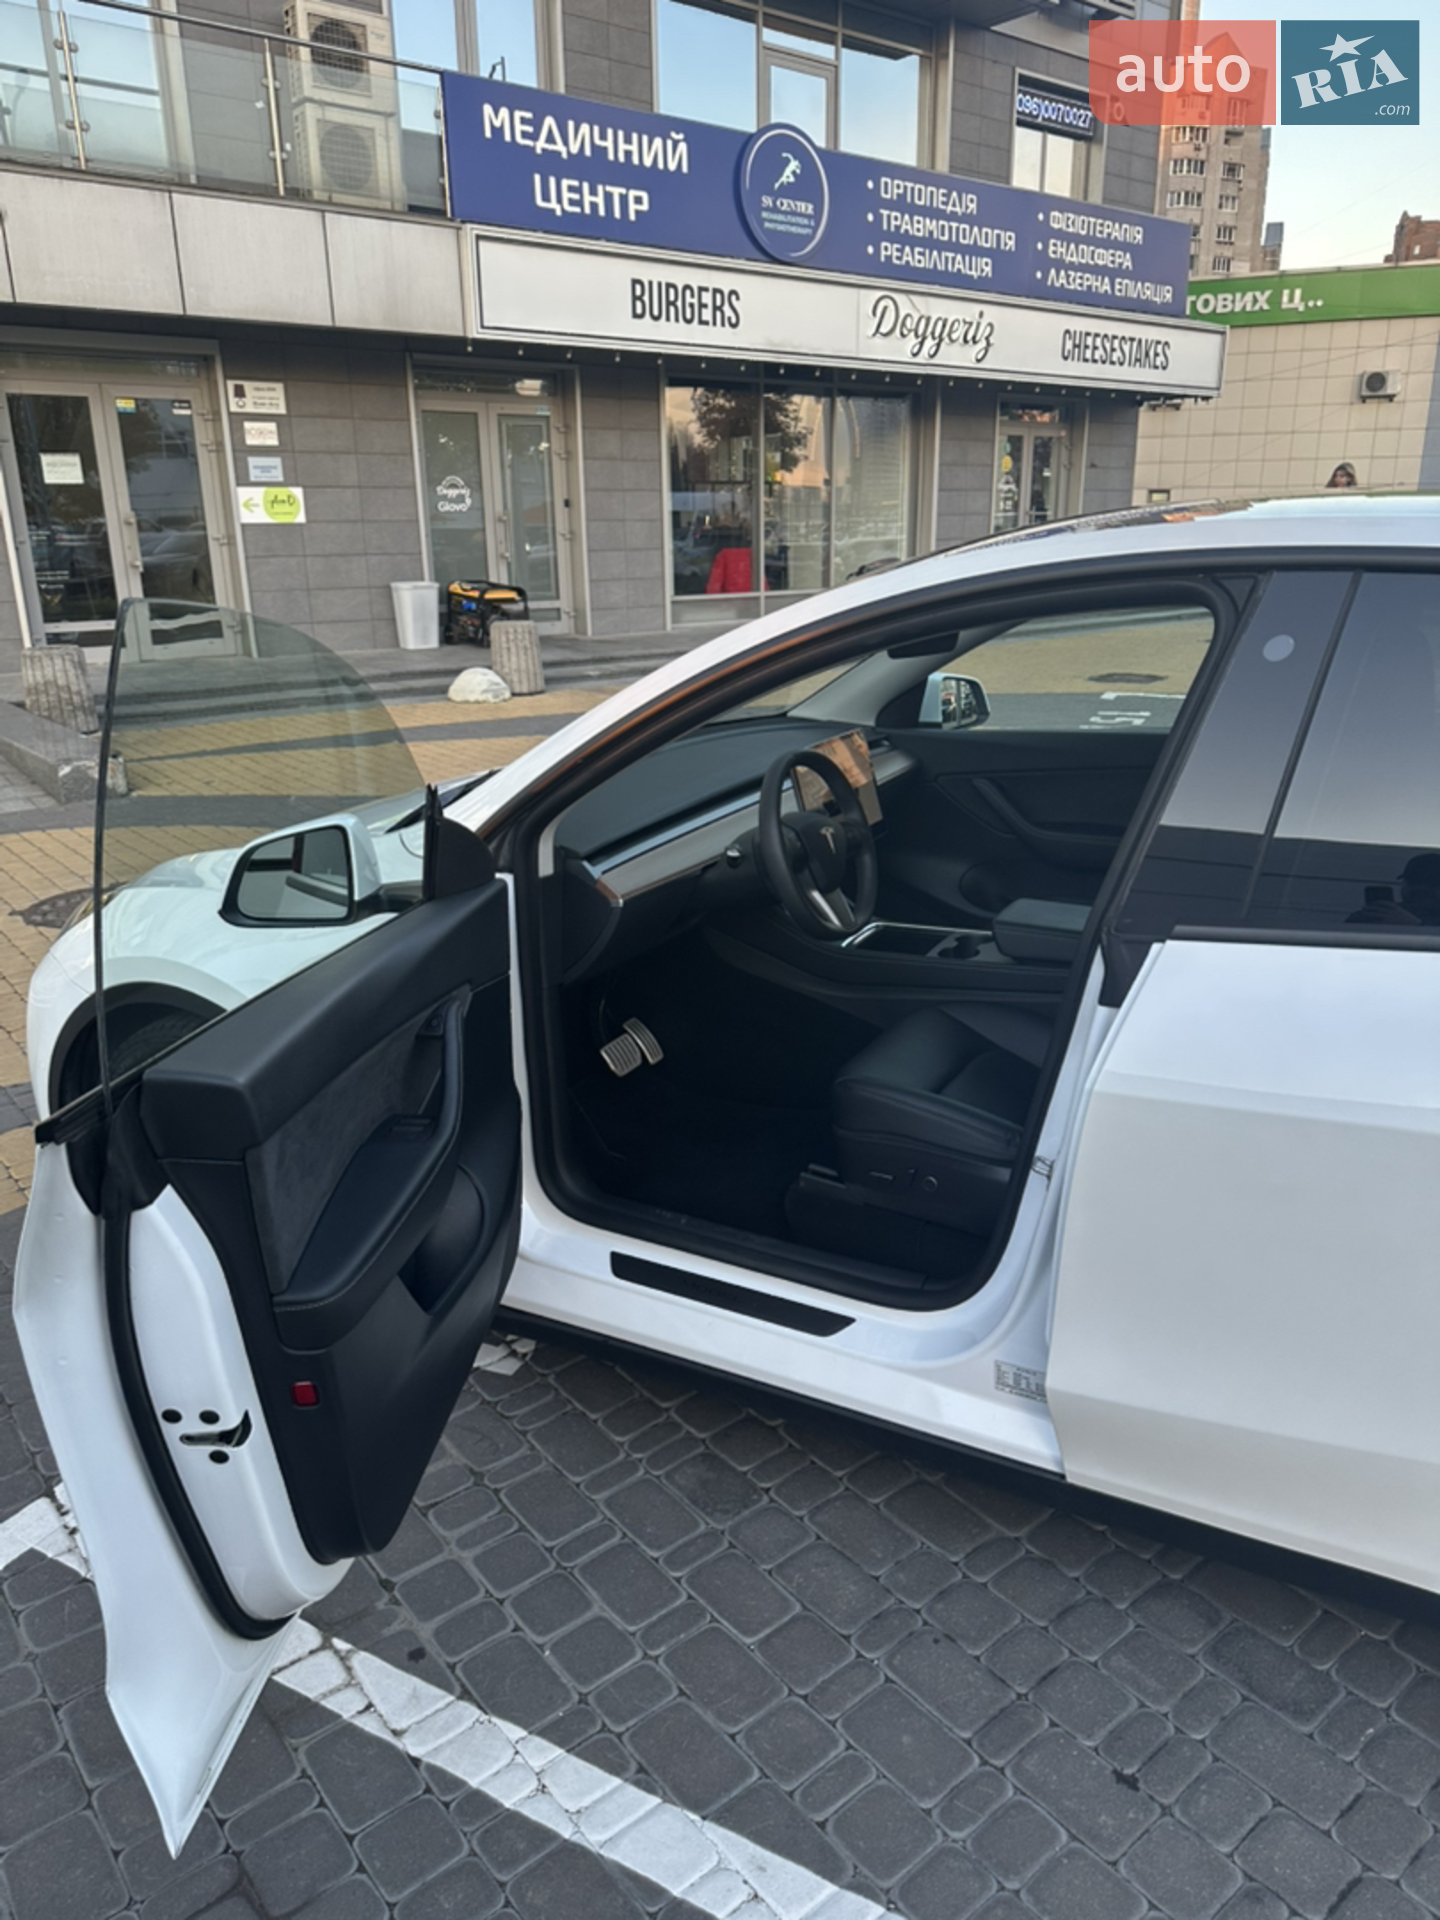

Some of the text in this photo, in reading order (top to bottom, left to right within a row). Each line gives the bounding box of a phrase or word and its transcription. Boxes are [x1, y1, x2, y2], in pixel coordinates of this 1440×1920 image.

[482, 102, 689, 174] МЕДИЧНИЙ
[533, 172, 650, 222] ЦЕНТР
[880, 176, 977, 216] ОРТОПЕДІЯ
[879, 208, 1016, 252] ТРАВМОТОЛОГІЯ
[1049, 210, 1144, 245] ФІЗІОТЕРАПІЯ
[880, 241, 993, 280] РЕАБІЛІТАЦІЯ
[1048, 238, 1133, 271] ЕНДОСФЕРА
[1047, 267, 1173, 305] ЛАЗЕРНА ЕПІЛЯЦІЯ
[631, 277, 1171, 371] BURGERS Doggeriz CHEESESTAKES
